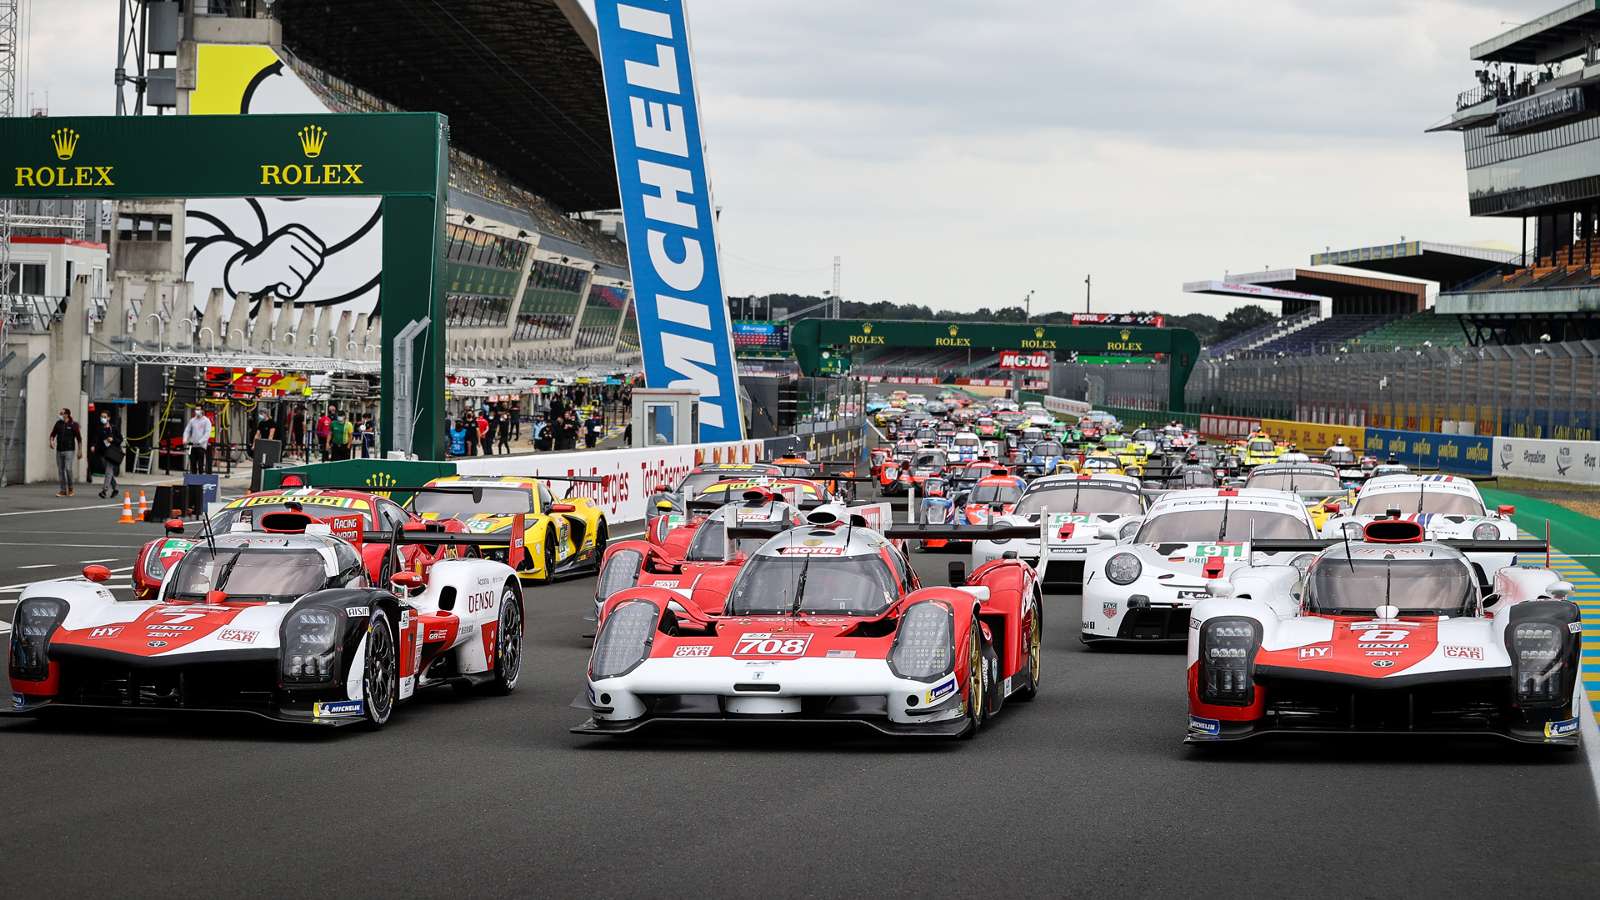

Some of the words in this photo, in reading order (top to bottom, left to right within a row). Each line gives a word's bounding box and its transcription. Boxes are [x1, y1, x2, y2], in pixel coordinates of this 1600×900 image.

[15, 167, 115, 186] ROLEX
[260, 164, 363, 185] ROLEX
[849, 335, 885, 345] ROLEX
[935, 337, 971, 347] ROLEX
[1021, 339, 1057, 349] ROLEX
[1107, 342, 1143, 351] ROLEX
[1002, 354, 1048, 368] MOTUL
[333, 518, 357, 529] RACING
[785, 547, 842, 556] MOTUL
[1203, 546, 1235, 556] 91
[468, 590, 494, 613] DENSO
[348, 606, 368, 617] AISIN
[161, 612, 206, 624] 7
[91, 627, 118, 637] HY
[1358, 630, 1410, 642] 8
[221, 633, 253, 643] CAR
[738, 639, 804, 654] 708
[1301, 647, 1329, 658] HY
[1447, 650, 1480, 659] CAR
[331, 704, 361, 713] MICHELIN
